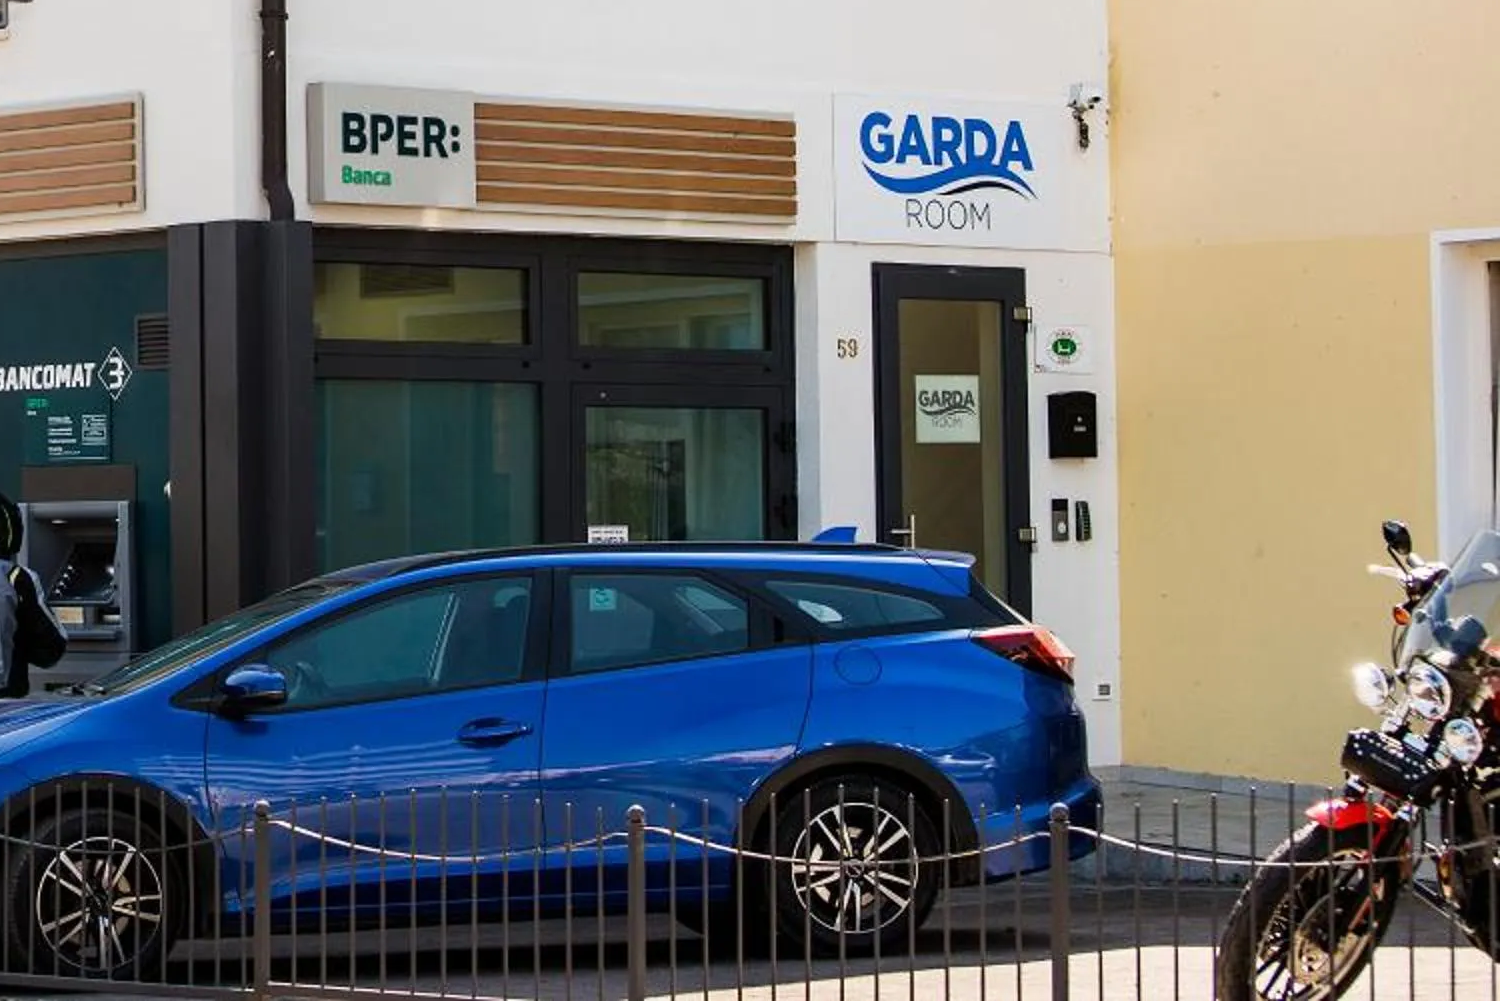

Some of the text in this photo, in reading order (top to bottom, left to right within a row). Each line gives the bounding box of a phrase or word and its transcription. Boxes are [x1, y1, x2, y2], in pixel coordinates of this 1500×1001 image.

[341, 111, 460, 159] BPER:
[859, 111, 1035, 172] GARDA
[341, 164, 392, 186] Banca
[905, 198, 992, 231] ROOM
[837, 338, 858, 359] 59
[918, 390, 975, 409] GARDA
